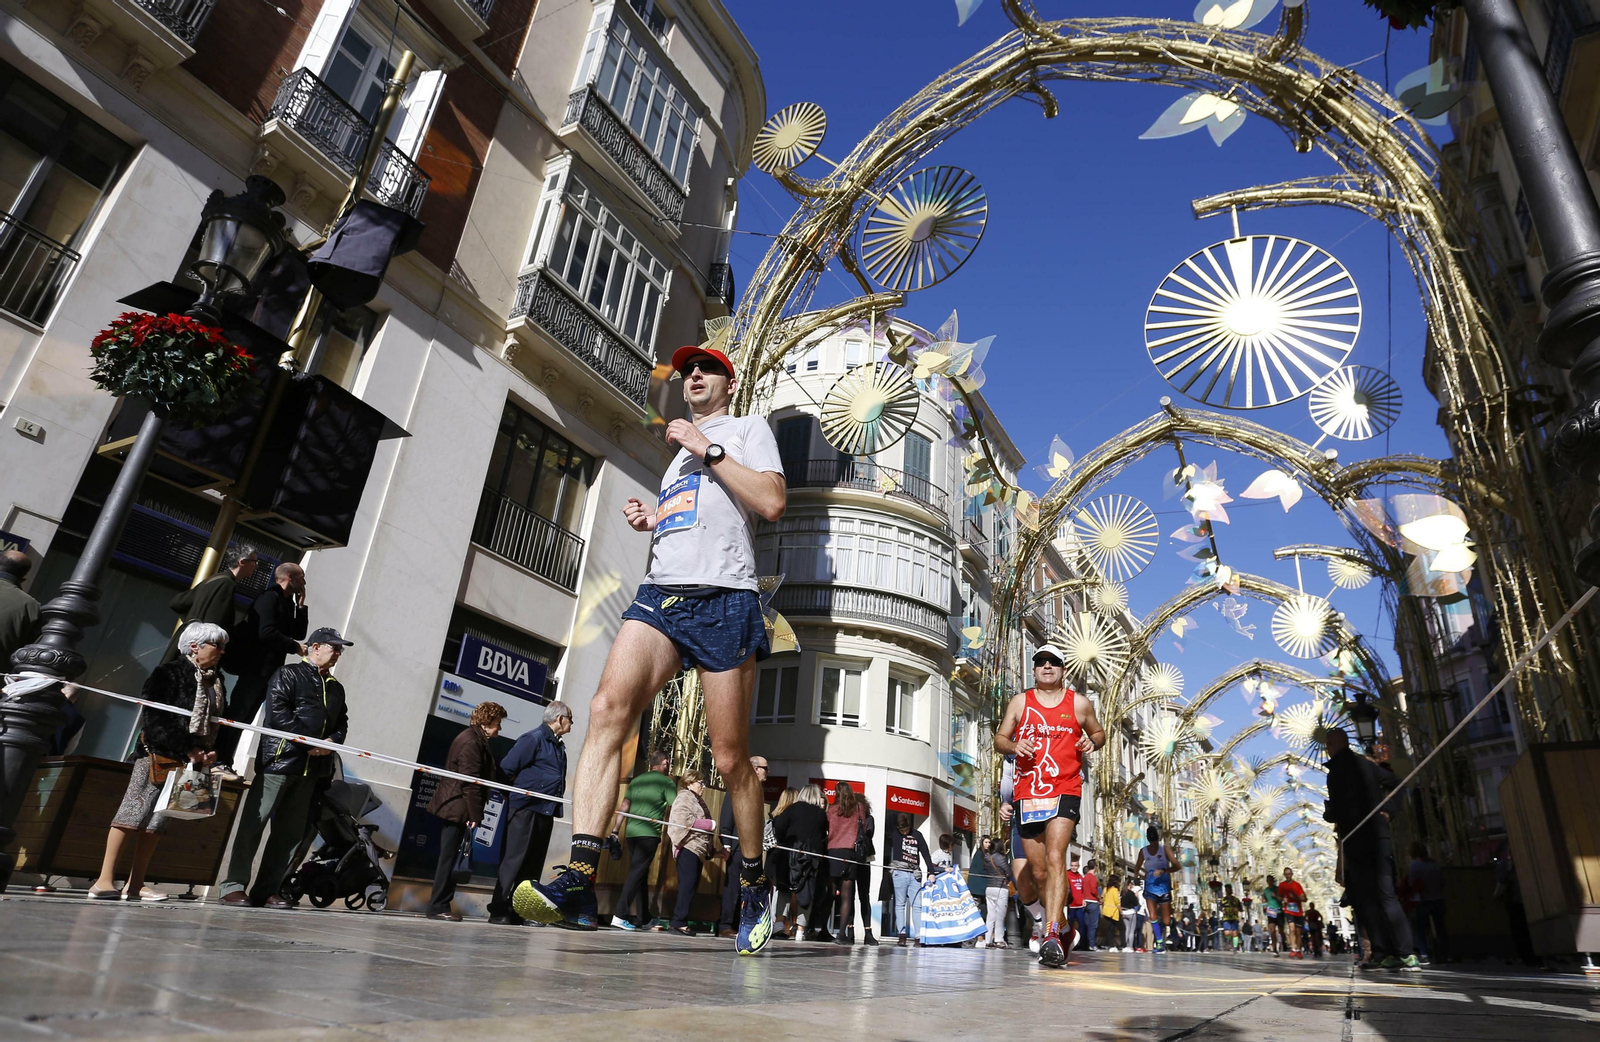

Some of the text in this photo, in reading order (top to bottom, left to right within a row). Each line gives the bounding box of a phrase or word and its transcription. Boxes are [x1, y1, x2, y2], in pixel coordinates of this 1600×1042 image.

[23, 421, 34, 432] 14
[478, 646, 529, 685] BBVA
[420, 779, 435, 788] para
[898, 795, 925, 808] Santander
